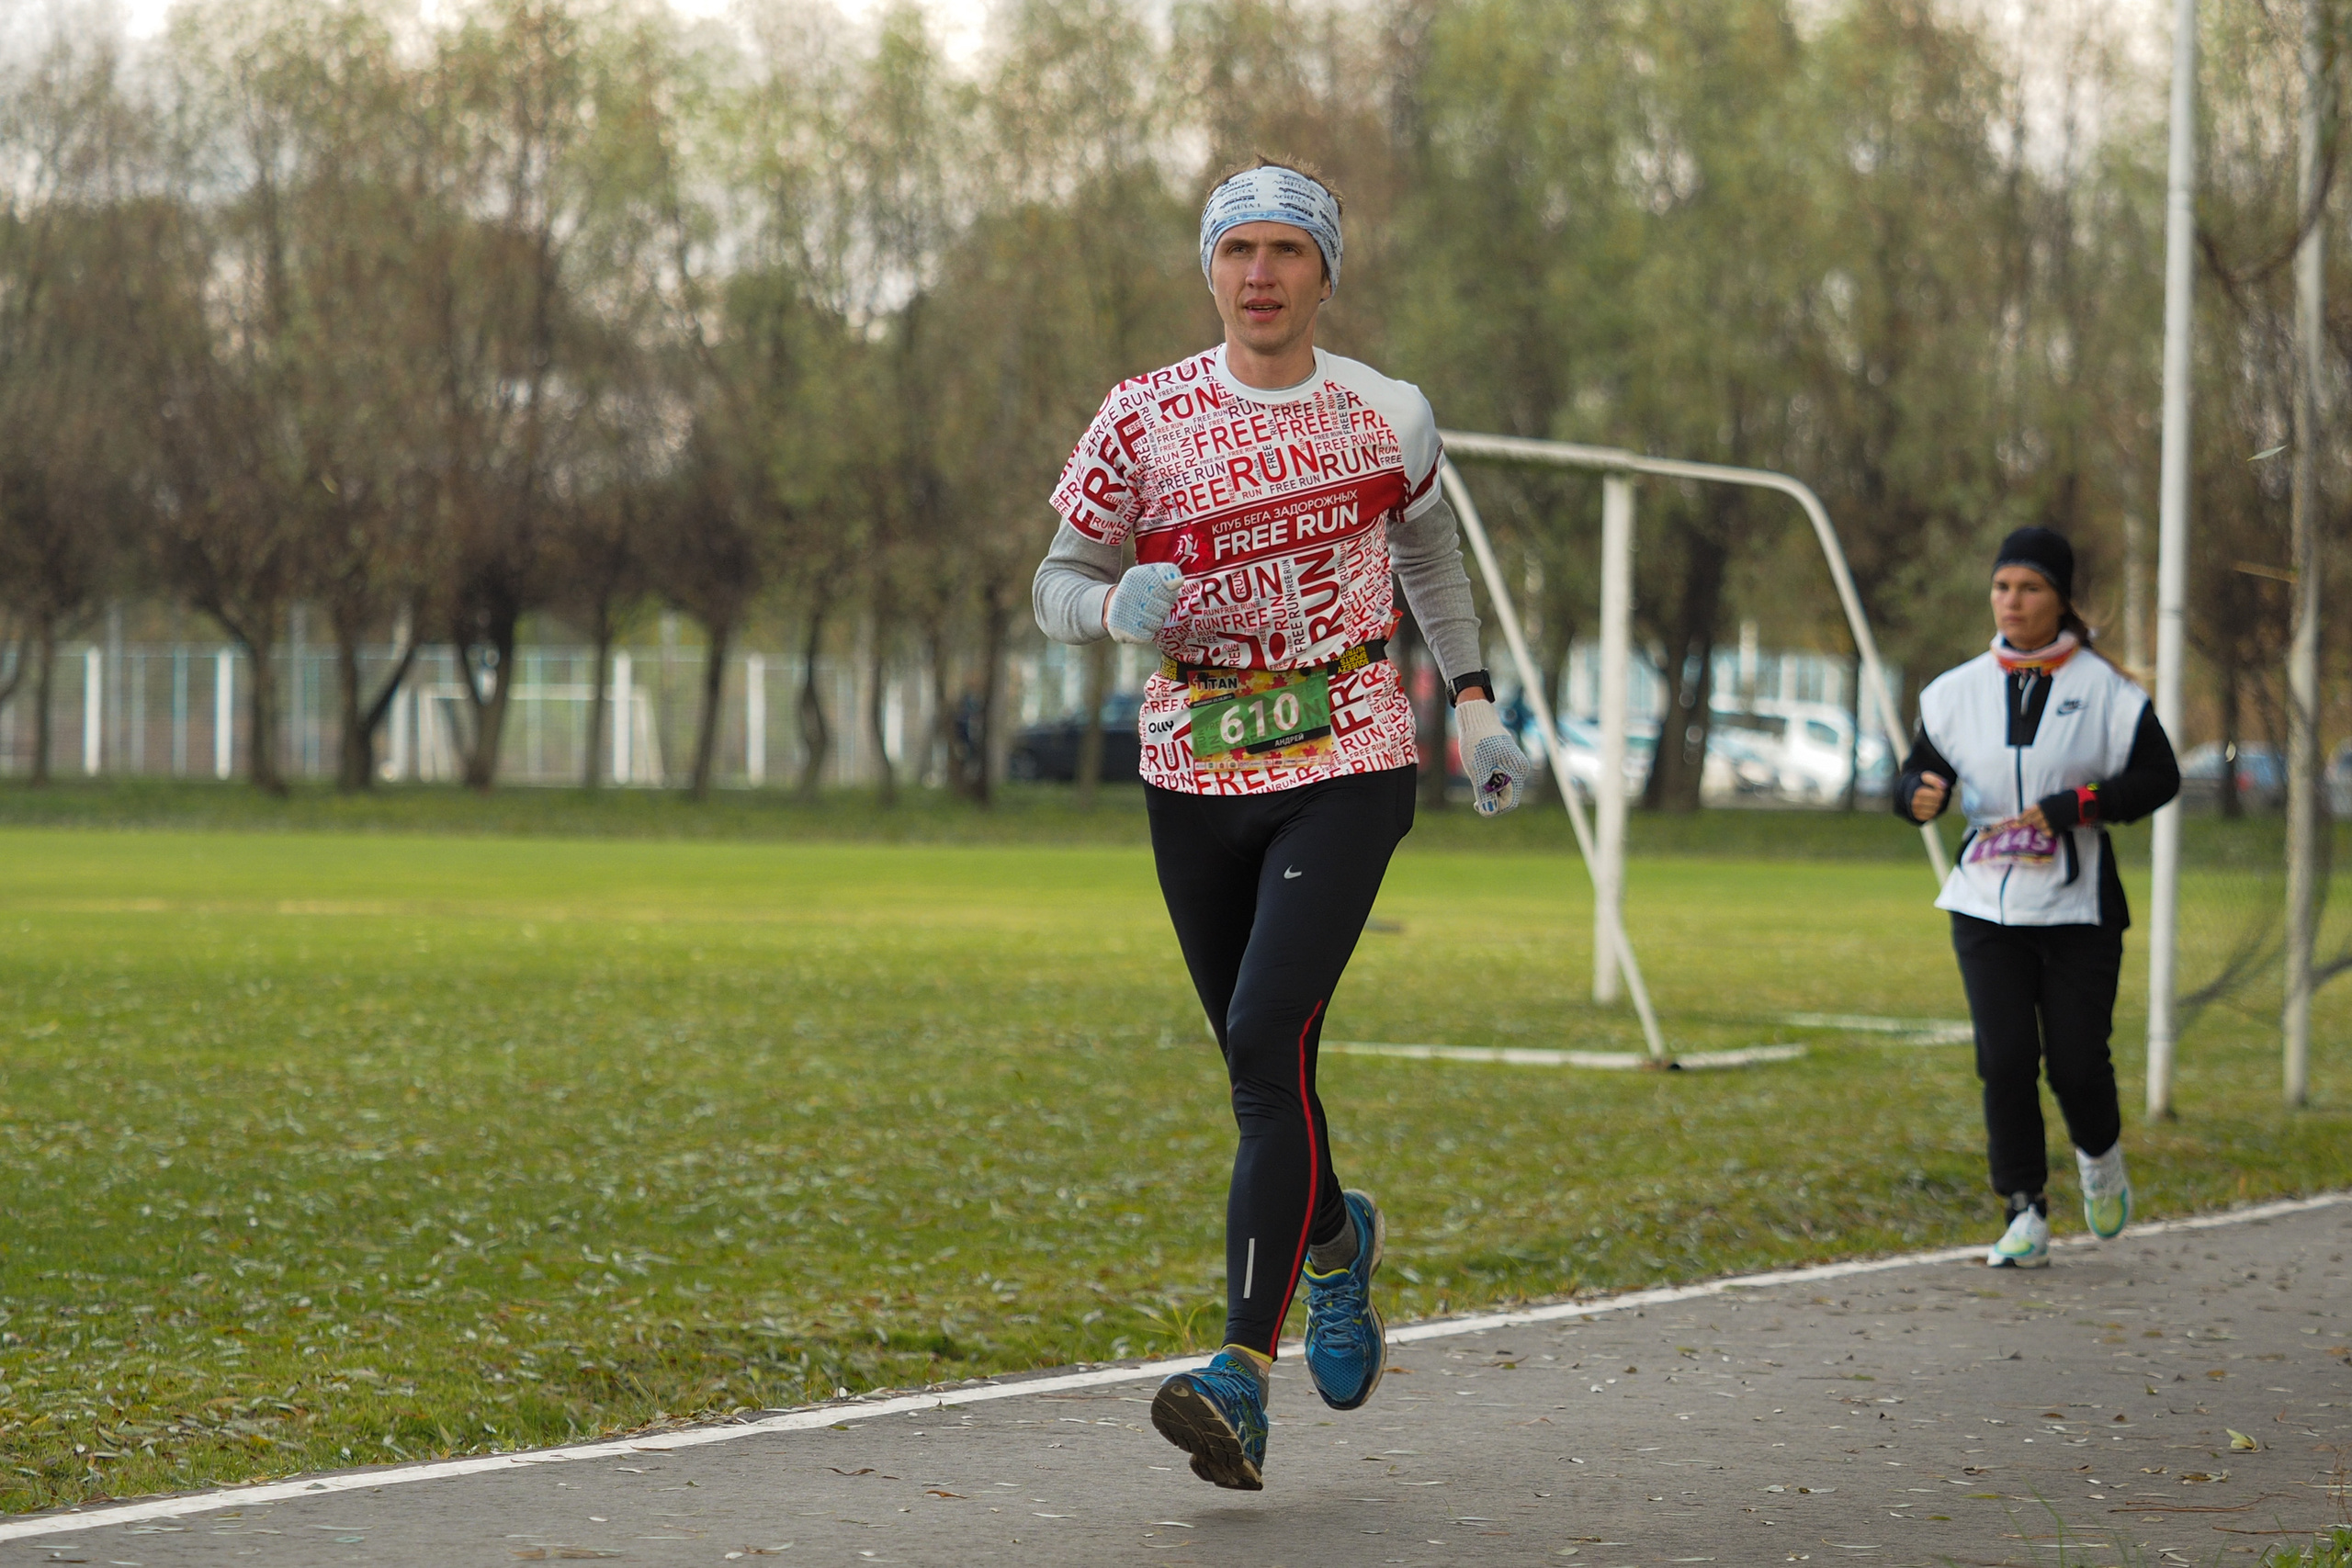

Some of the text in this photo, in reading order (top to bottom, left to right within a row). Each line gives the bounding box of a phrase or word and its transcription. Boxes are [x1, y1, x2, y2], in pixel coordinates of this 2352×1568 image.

[1152, 356, 1216, 390] RUN
[1159, 384, 1189, 398] FREE RUN
[1221, 398, 1237, 408] FREE
[1227, 400, 1266, 419] RUN
[1272, 401, 1314, 423] FREE
[1327, 394, 1340, 429] FREE RUN
[1335, 392, 1351, 434] FREE RUN
[1089, 388, 1156, 448] FREE RUN
[1126, 420, 1144, 434] FREE
[1140, 406, 1156, 429] RUN
[1193, 409, 1227, 424] FREE RUN
[1208, 418, 1226, 427] FREE
[1267, 419, 1278, 435] RUN
[1276, 413, 1332, 441] FREE
[1154, 422, 1183, 435] FREE RUN
[1157, 423, 1204, 445] FREE RUN
[1193, 414, 1272, 459] FREE
[1159, 443, 1177, 452] FREE
[1179, 437, 1197, 468] RUN
[1228, 446, 1258, 457] FREE RUN
[1298, 438, 1306, 451] RUN
[1316, 432, 1376, 455] FREE RUN
[1378, 446, 1399, 456] RUN
[1154, 451, 1180, 466] RUN
[1227, 441, 1319, 492] RUN
[1262, 444, 1277, 469] FREE
[1318, 445, 1381, 480] RUN
[1380, 455, 1402, 466] FREE
[1152, 461, 1183, 480] FREE
[1158, 461, 1227, 493] FREE RUN
[1242, 488, 1262, 500] RUN
[1270, 475, 1320, 494] FREE RUN
[1105, 493, 1125, 506] RUN
[1159, 478, 1230, 521] FREE
[1212, 490, 1358, 535] КЛУБ БЕГА ЗАДОРОЖНЫХ
[1092, 517, 1116, 531] RUN
[1214, 502, 1358, 560] FREE RUN
[1201, 562, 1283, 608] RUN
[1233, 570, 1245, 594] RUN
[1282, 559, 1295, 592] FREE RUN
[1181, 582, 1199, 595] RUN
[1294, 548, 1345, 645] RUN
[1204, 602, 1257, 616] RUN FREE RUN
[1270, 595, 1289, 631] RUN
[1285, 592, 1301, 619] RUN
[1195, 607, 1269, 632] RUN FREE
[1197, 636, 1218, 644] FREE
[1291, 622, 1306, 653] FREE
[1270, 660, 1288, 671] FREE
[1338, 658, 1369, 673] SQUEEZY
[1340, 651, 1367, 665] SPORTS
[1144, 699, 1178, 714] FREE
[1220, 694, 1299, 745] 610
[1274, 733, 1305, 747] АНДРЕЙ
[1340, 725, 1385, 754] RUN
[1145, 739, 1193, 772] RUN
[1350, 741, 1386, 761] FREE RUN
[1351, 750, 1396, 773] RUN
[1155, 772, 1193, 790] RUN
[1193, 767, 1289, 795] FREE
[1275, 777, 1296, 790] RUN
